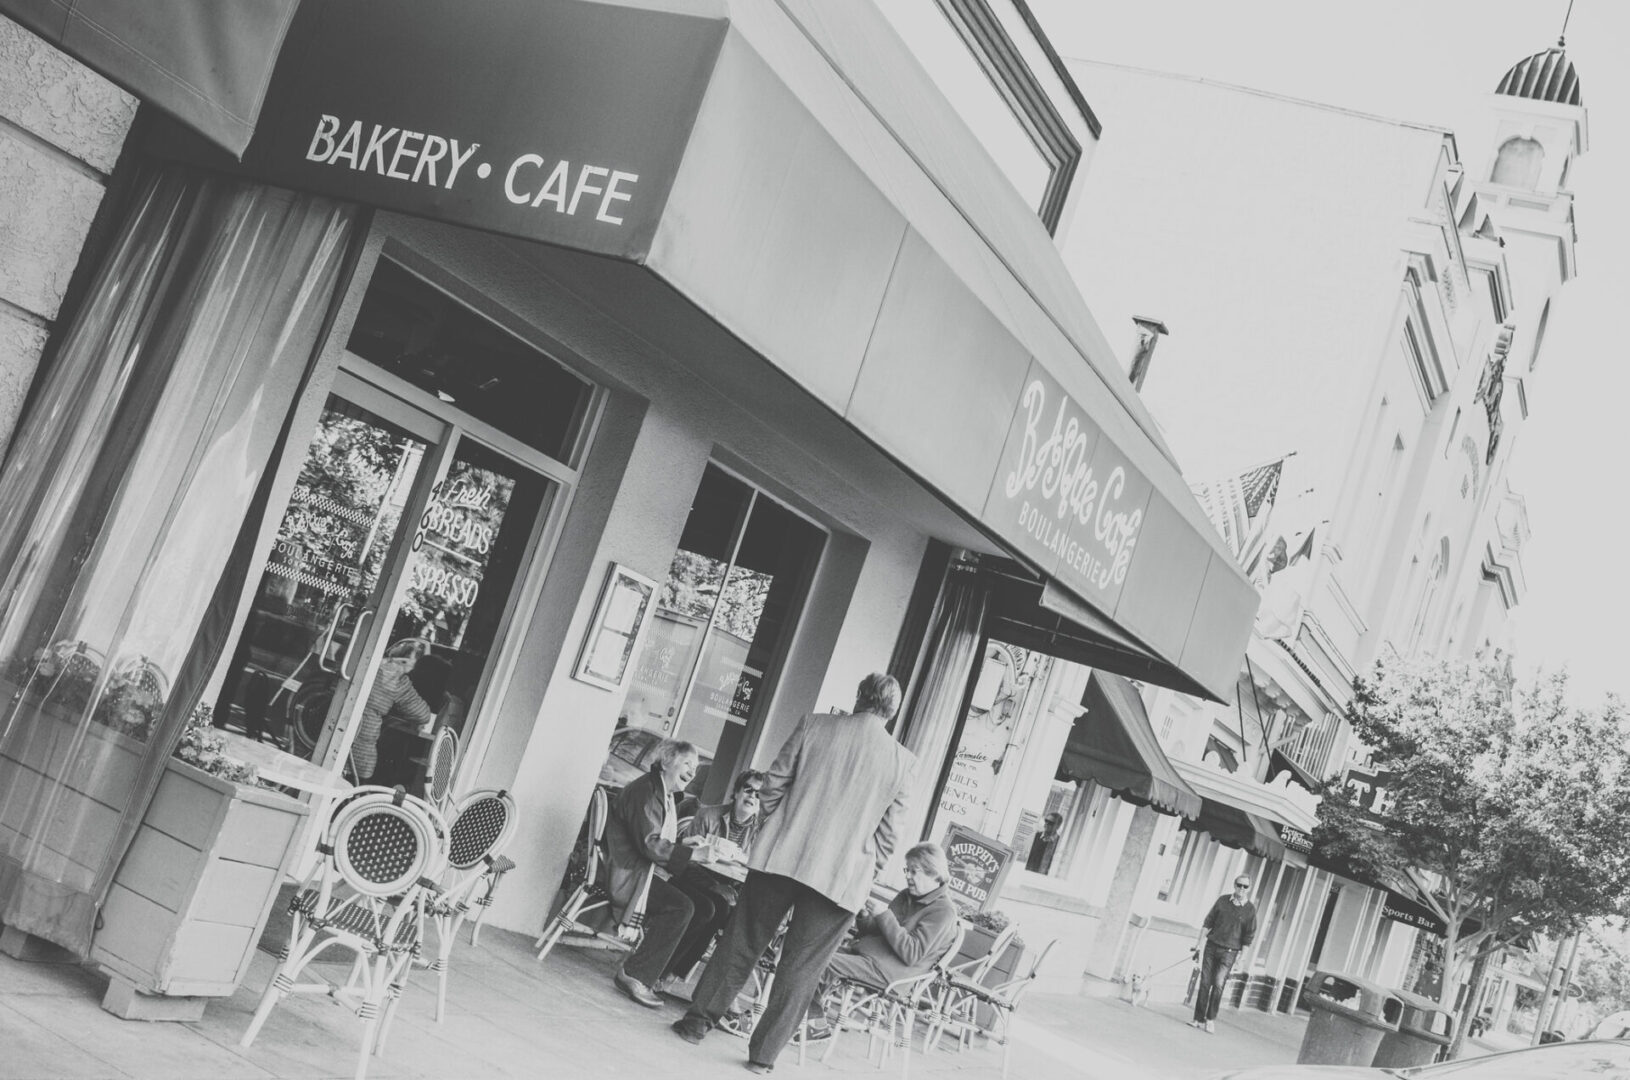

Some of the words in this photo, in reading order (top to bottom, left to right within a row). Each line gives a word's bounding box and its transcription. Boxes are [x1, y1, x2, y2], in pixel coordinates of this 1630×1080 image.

[306, 114, 480, 190] BAKERY
[504, 153, 640, 226] CAFE
[443, 479, 491, 510] Fresh
[427, 501, 493, 554] BREADS
[1018, 501, 1101, 583] BOULANGERIE
[271, 540, 354, 577] BOULANGERIE
[949, 772, 978, 789] UILTS
[1347, 778, 1397, 817] TH
[948, 876, 966, 891] ISH
[965, 883, 988, 901] PUB
[1382, 904, 1414, 922] Sports
[1417, 916, 1436, 929] Bar
